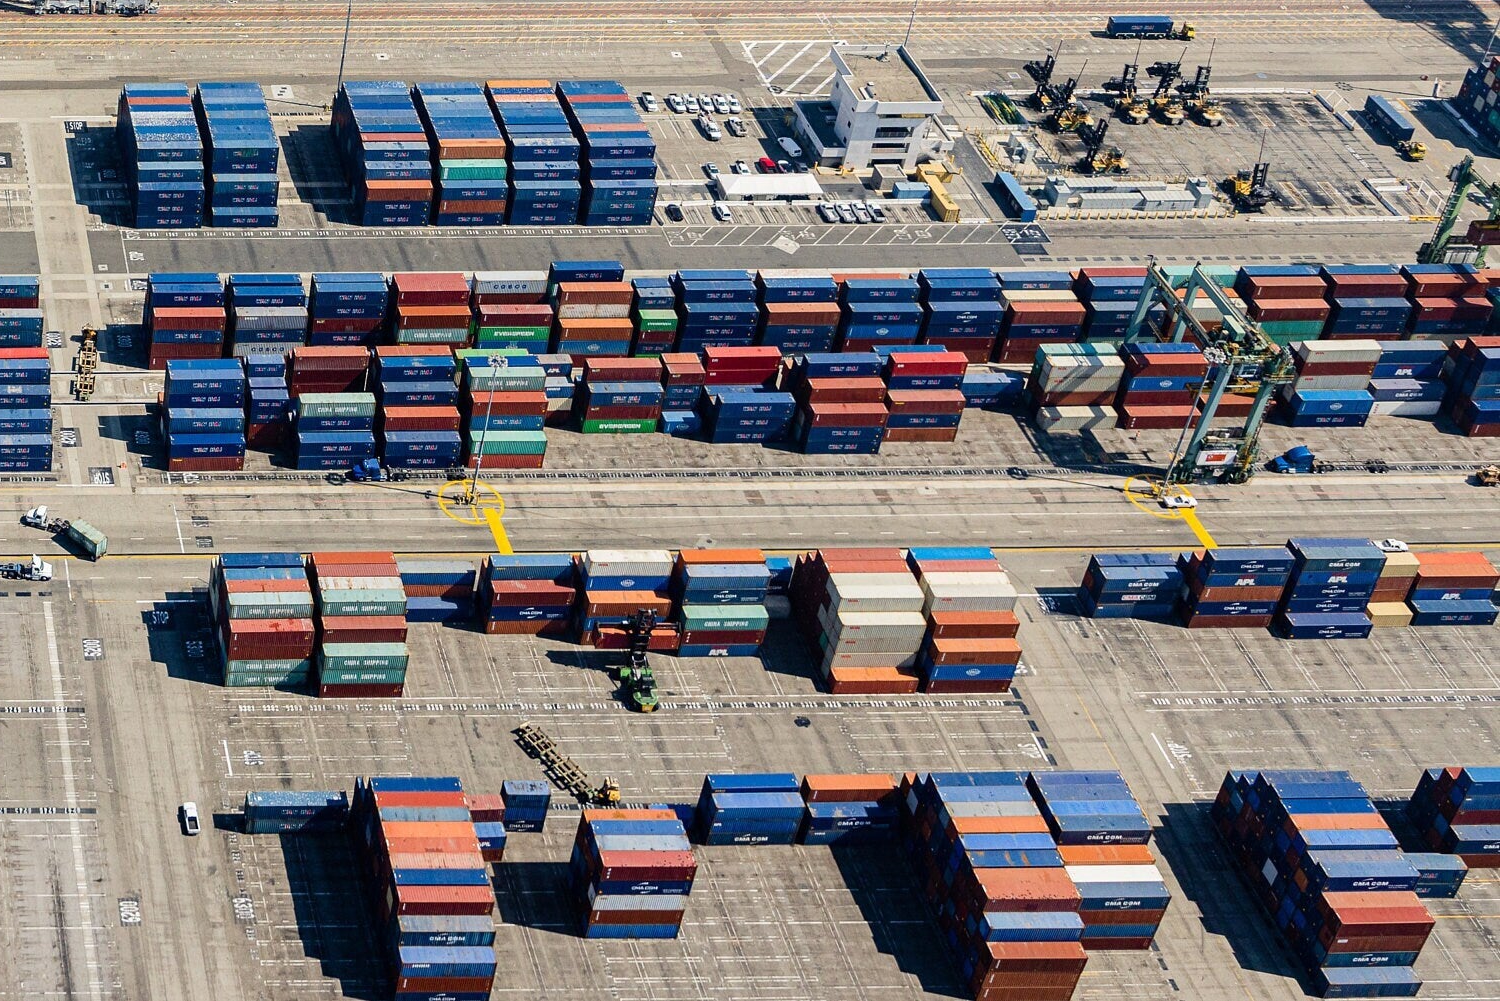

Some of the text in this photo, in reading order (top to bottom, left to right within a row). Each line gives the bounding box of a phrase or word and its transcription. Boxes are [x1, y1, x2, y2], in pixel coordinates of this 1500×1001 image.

[69, 122, 83, 130] STOP
[93, 472, 110, 485] STOP
[152, 610, 168, 624] STOP
[83, 638, 102, 656] 5200
[119, 900, 141, 922] 6200
